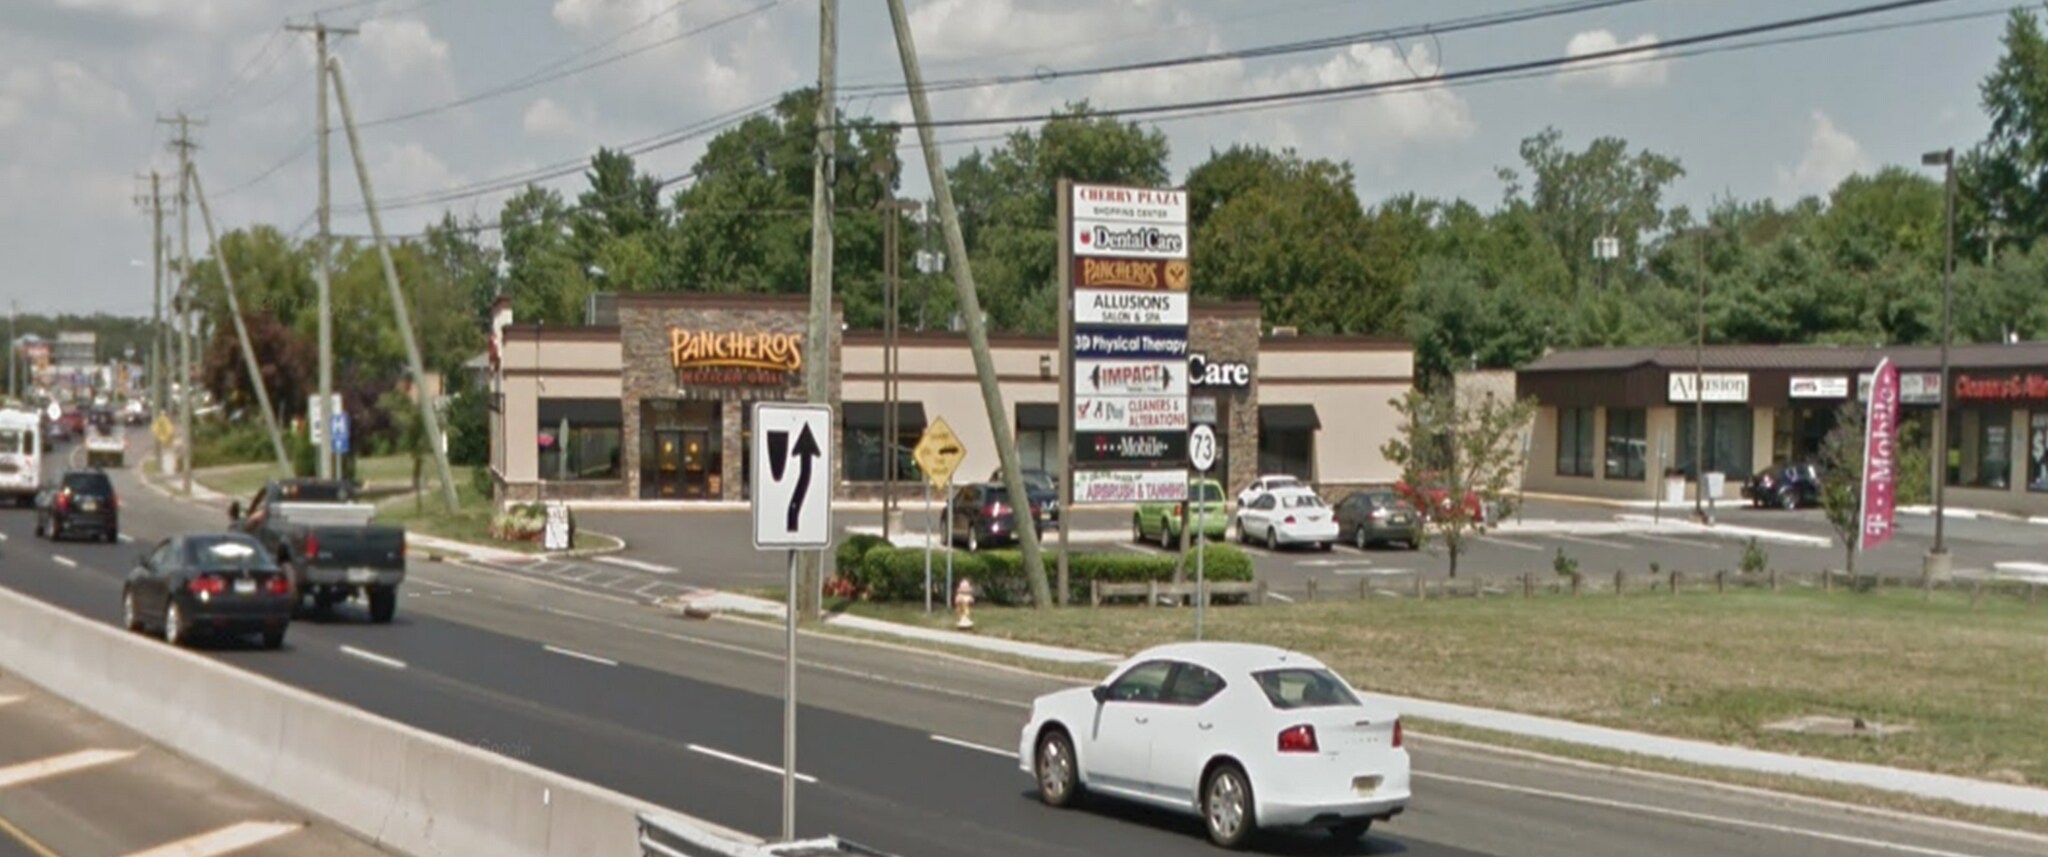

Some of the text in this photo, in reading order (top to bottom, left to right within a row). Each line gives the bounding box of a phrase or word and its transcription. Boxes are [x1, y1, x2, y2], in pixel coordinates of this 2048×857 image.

[1079, 188, 1180, 206] CHERRY PLAZA
[1093, 206, 1168, 219] SHOPPING CENTER
[1094, 226, 1182, 252] Dental Care
[1084, 258, 1158, 289] PANCHEROS
[1093, 295, 1170, 311] ALLUSIONS
[1102, 311, 1161, 322] SALON & SPA
[669, 325, 803, 371] PANCHEROS
[1075, 335, 1188, 354] 3D Physical Therapy
[1102, 365, 1161, 385] IMPACT
[1189, 354, 1249, 385] Care
[1129, 400, 1171, 413] CLEANERS
[1129, 413, 1185, 427] ALTERATIONS
[1194, 434, 1212, 461] 73
